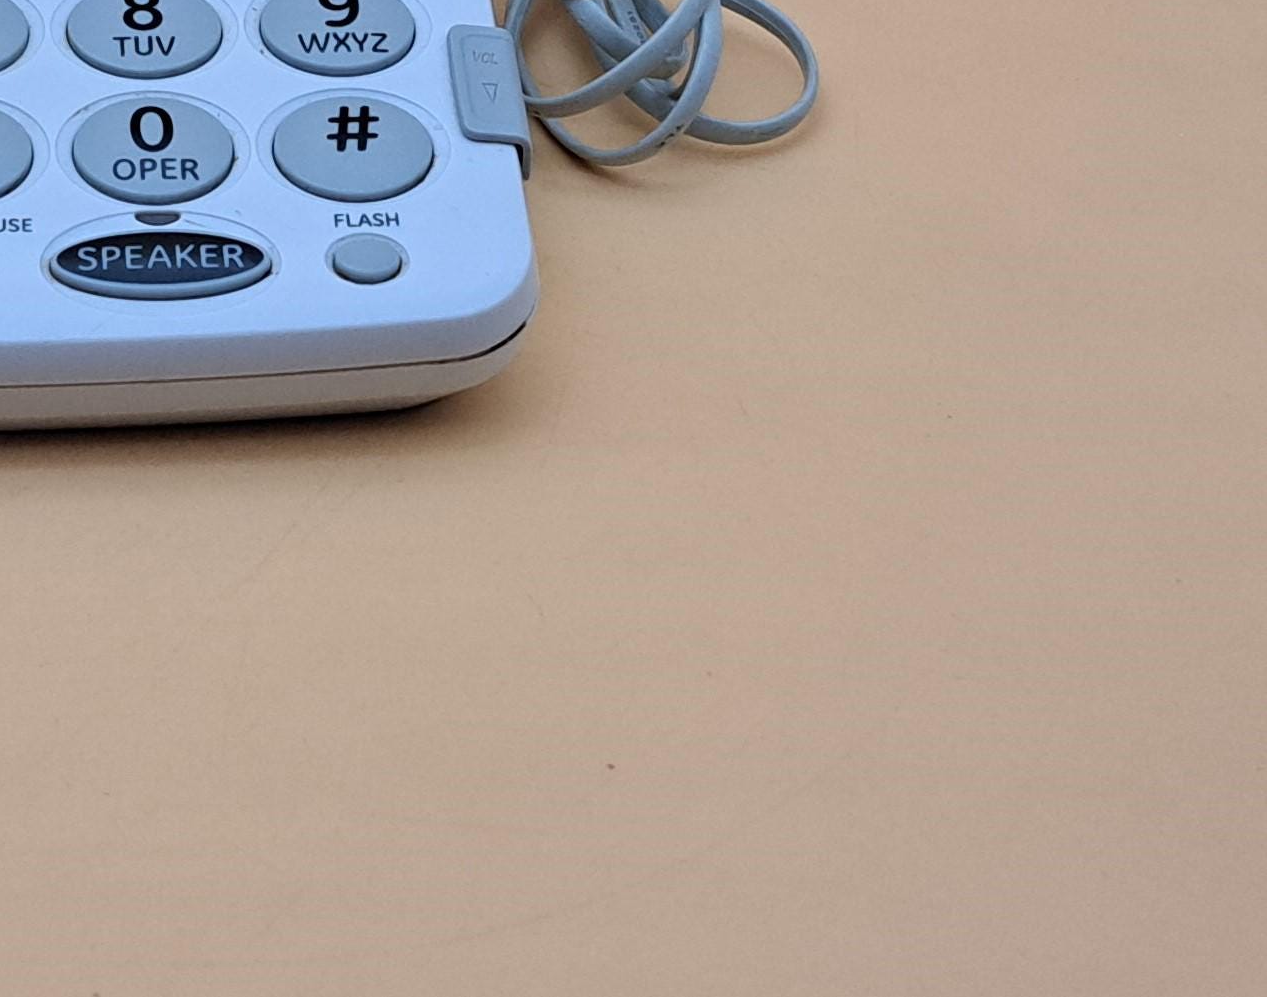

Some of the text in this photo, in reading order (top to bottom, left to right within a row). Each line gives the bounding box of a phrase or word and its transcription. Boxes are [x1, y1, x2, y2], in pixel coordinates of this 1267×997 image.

[112, 35, 176, 57] TUV
[298, 32, 390, 54] WXYZ
[472, 50, 499, 65] VOL
[129, 106, 173, 154] 0
[326, 105, 380, 153] #
[112, 157, 200, 182] OPER
[333, 211, 400, 229] FLASH
[77, 244, 244, 273] SPEAKER
